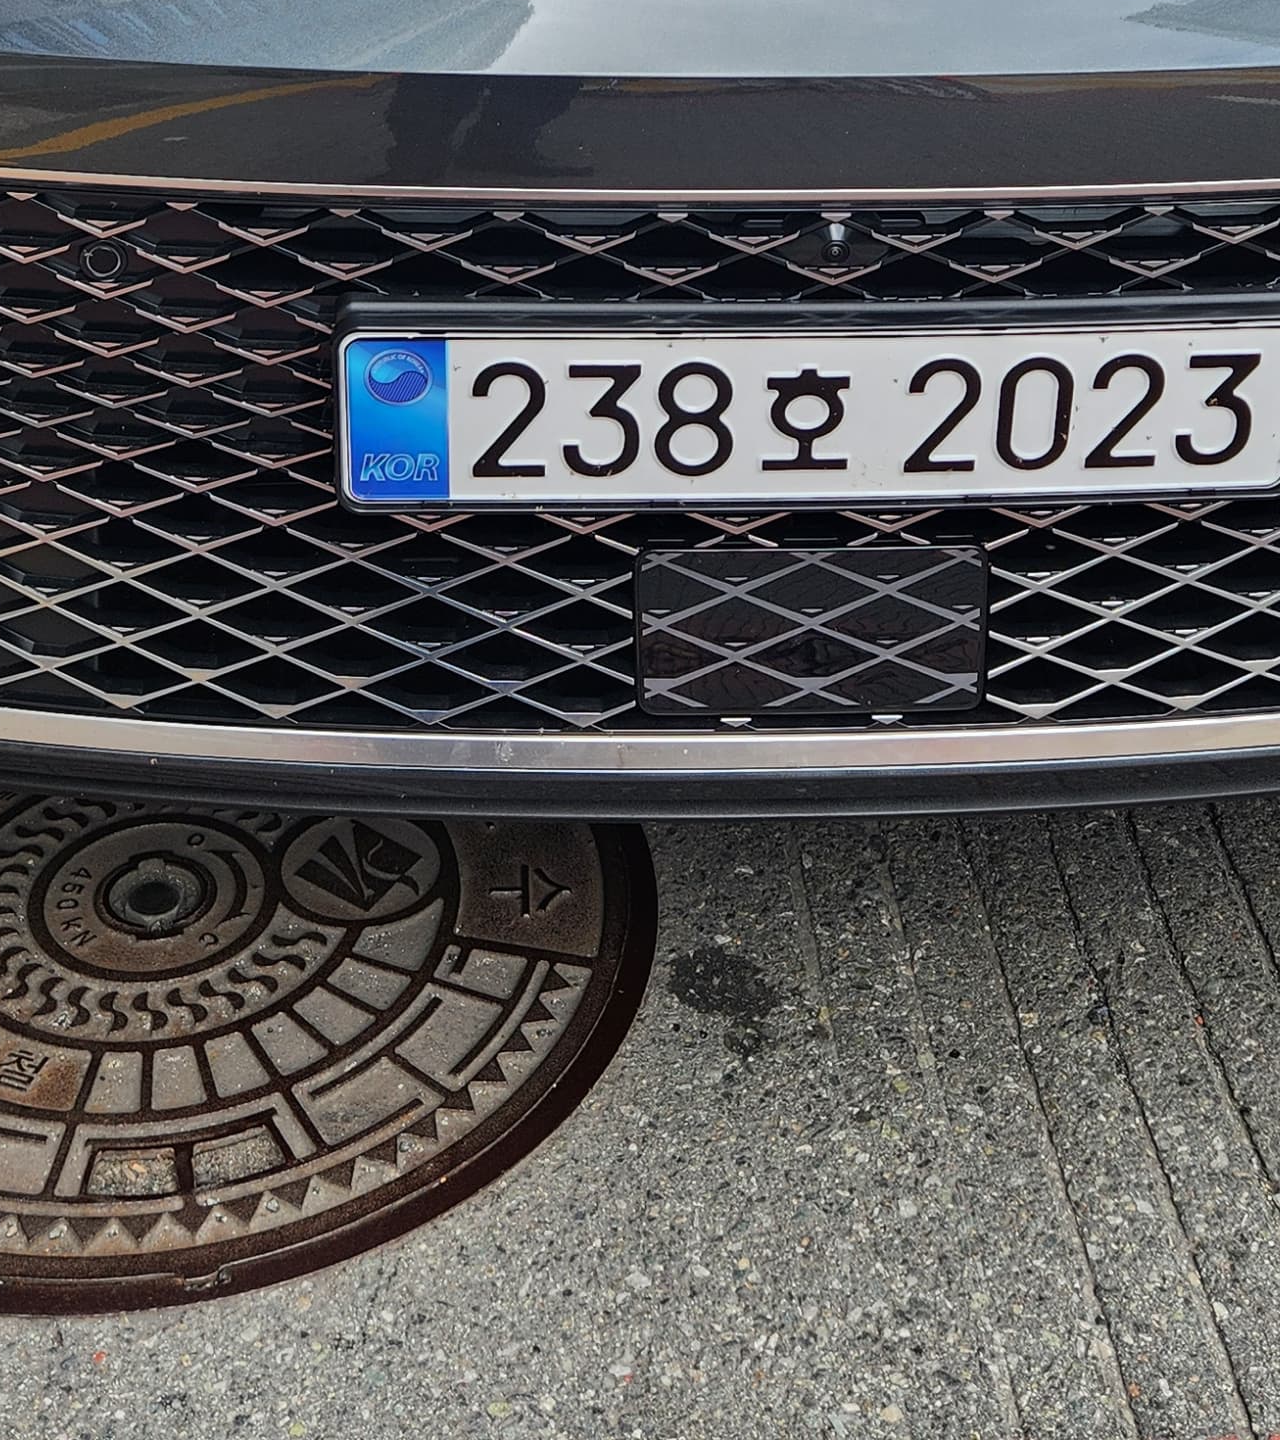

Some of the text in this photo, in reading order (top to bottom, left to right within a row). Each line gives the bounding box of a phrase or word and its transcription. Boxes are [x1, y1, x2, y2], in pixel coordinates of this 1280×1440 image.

[470, 353, 1262, 478] 238호 2023
[360, 453, 440, 482] KOR
